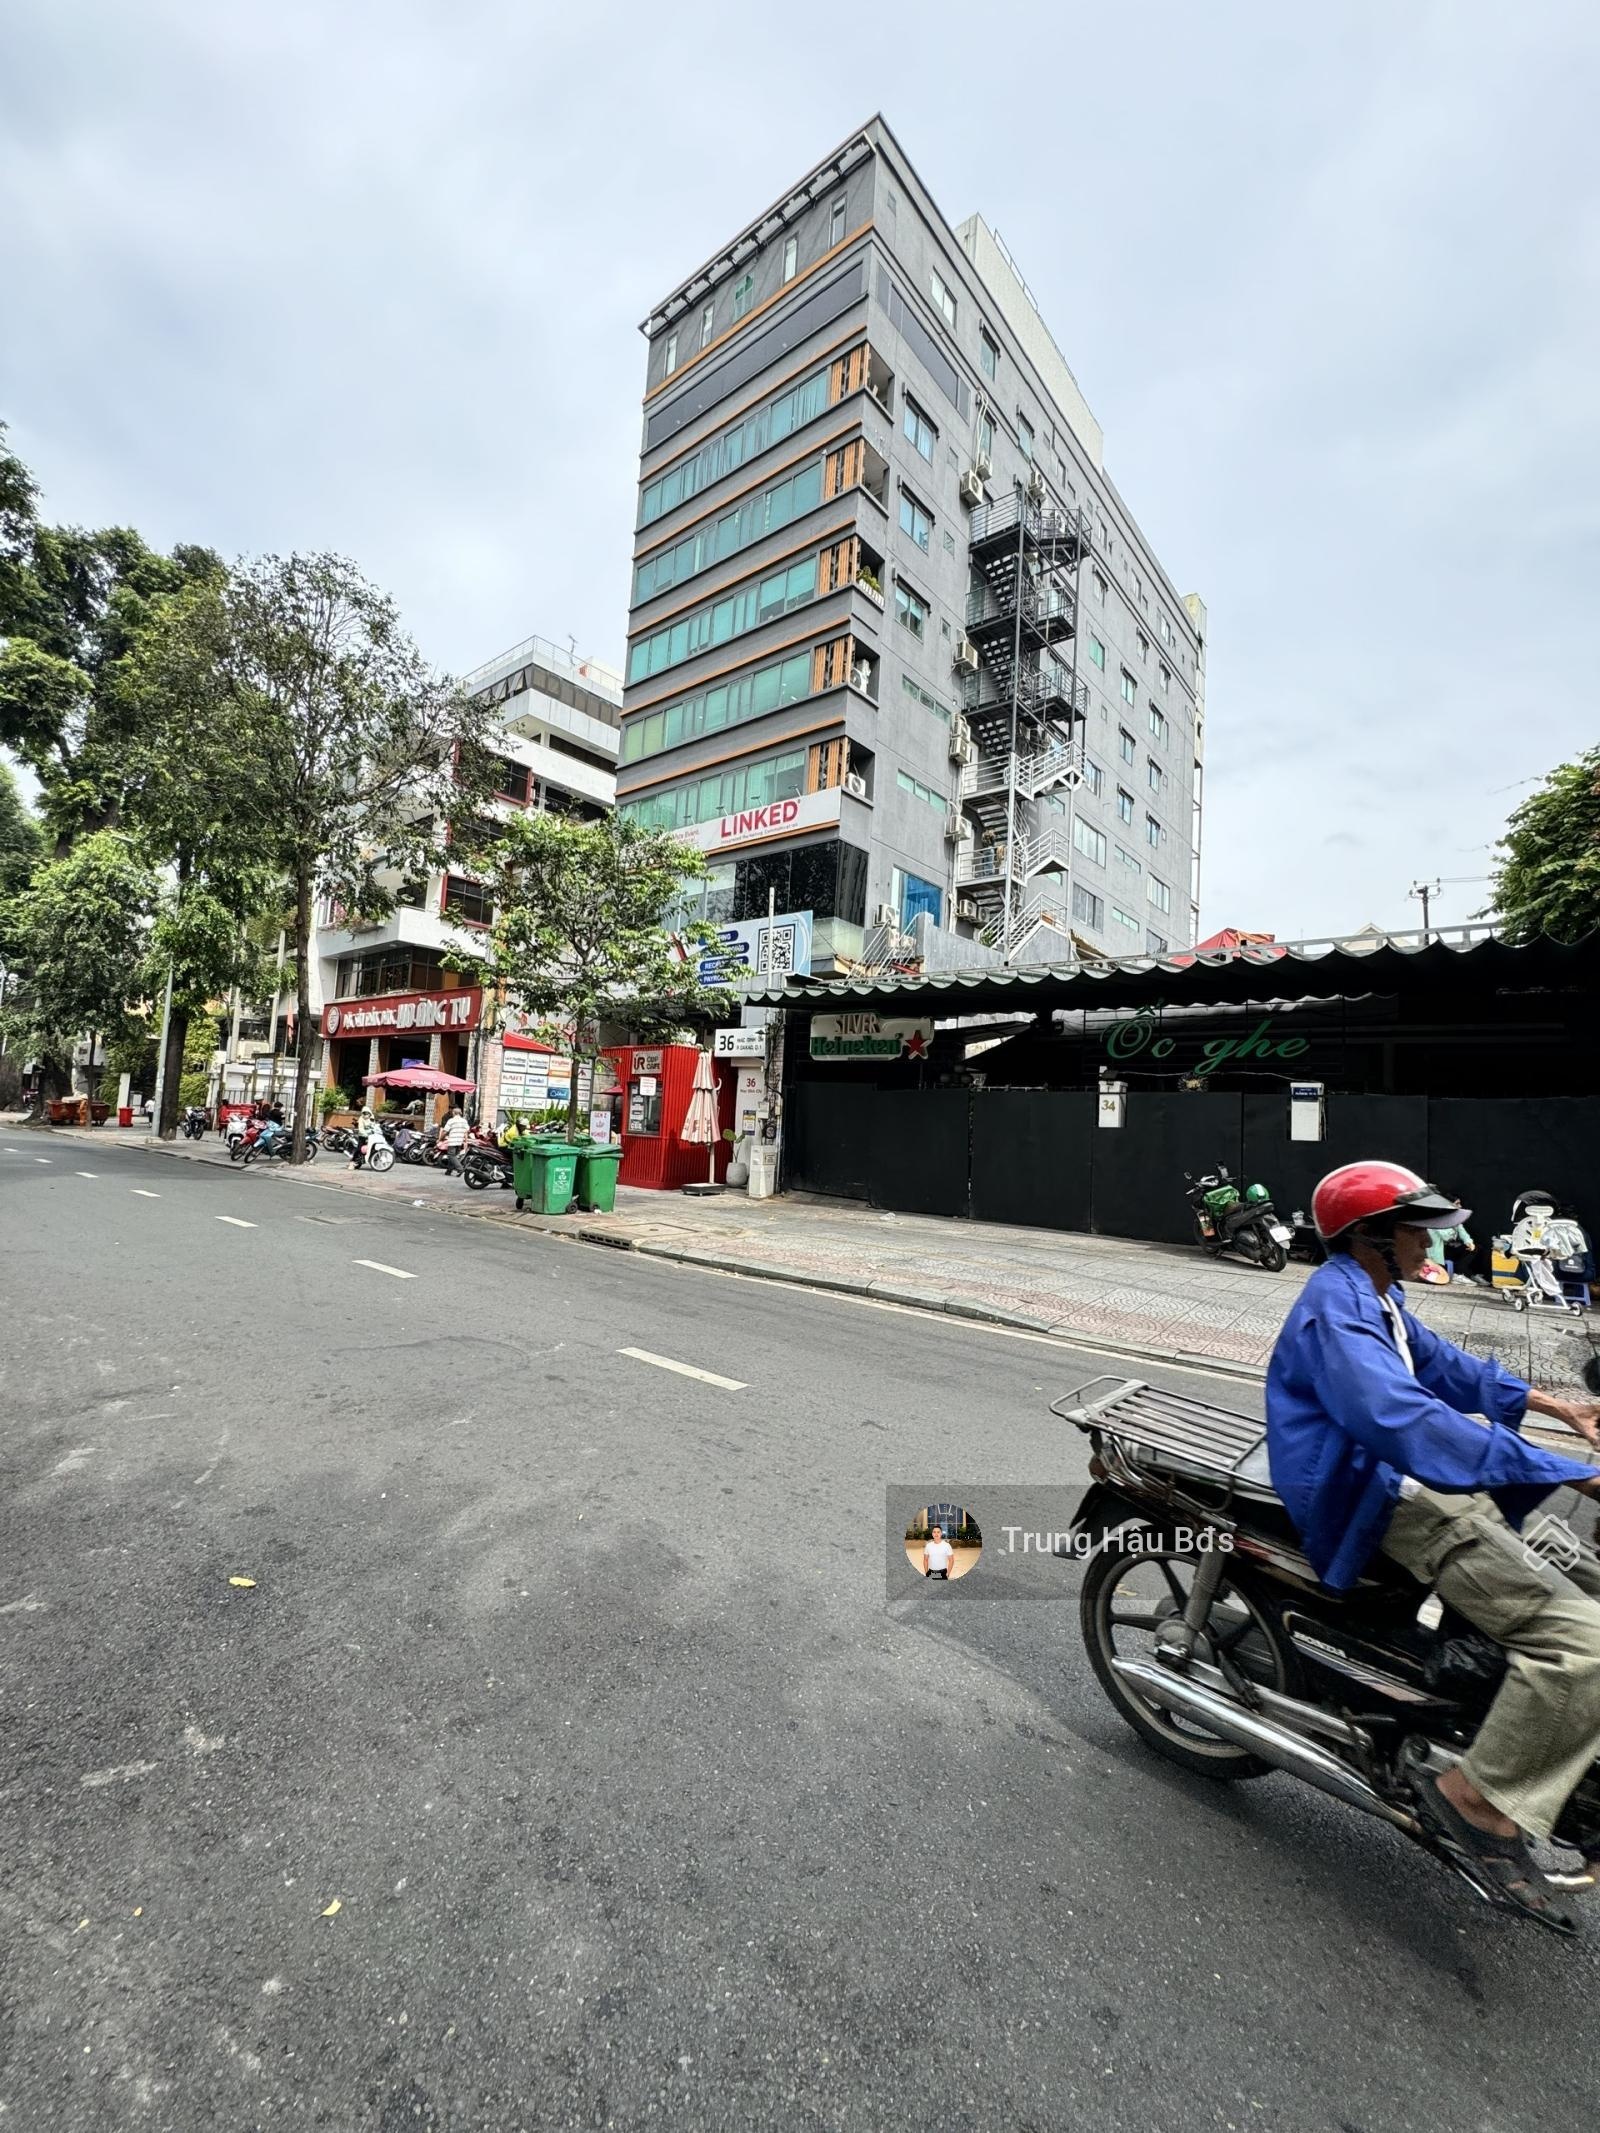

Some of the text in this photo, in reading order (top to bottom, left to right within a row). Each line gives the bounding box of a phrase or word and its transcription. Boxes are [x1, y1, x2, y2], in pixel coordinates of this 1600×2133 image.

[720, 801, 799, 838] LINKED
[835, 1013, 880, 1034] SILVER
[719, 1035, 735, 1051] 36
[811, 1035, 901, 1055] Heineken
[1194, 1019, 1310, 1075] ghe
[746, 1078, 756, 1087] 36
[1101, 1099, 1116, 1112] 34
[1293, 1630, 1347, 1659] HONDA
